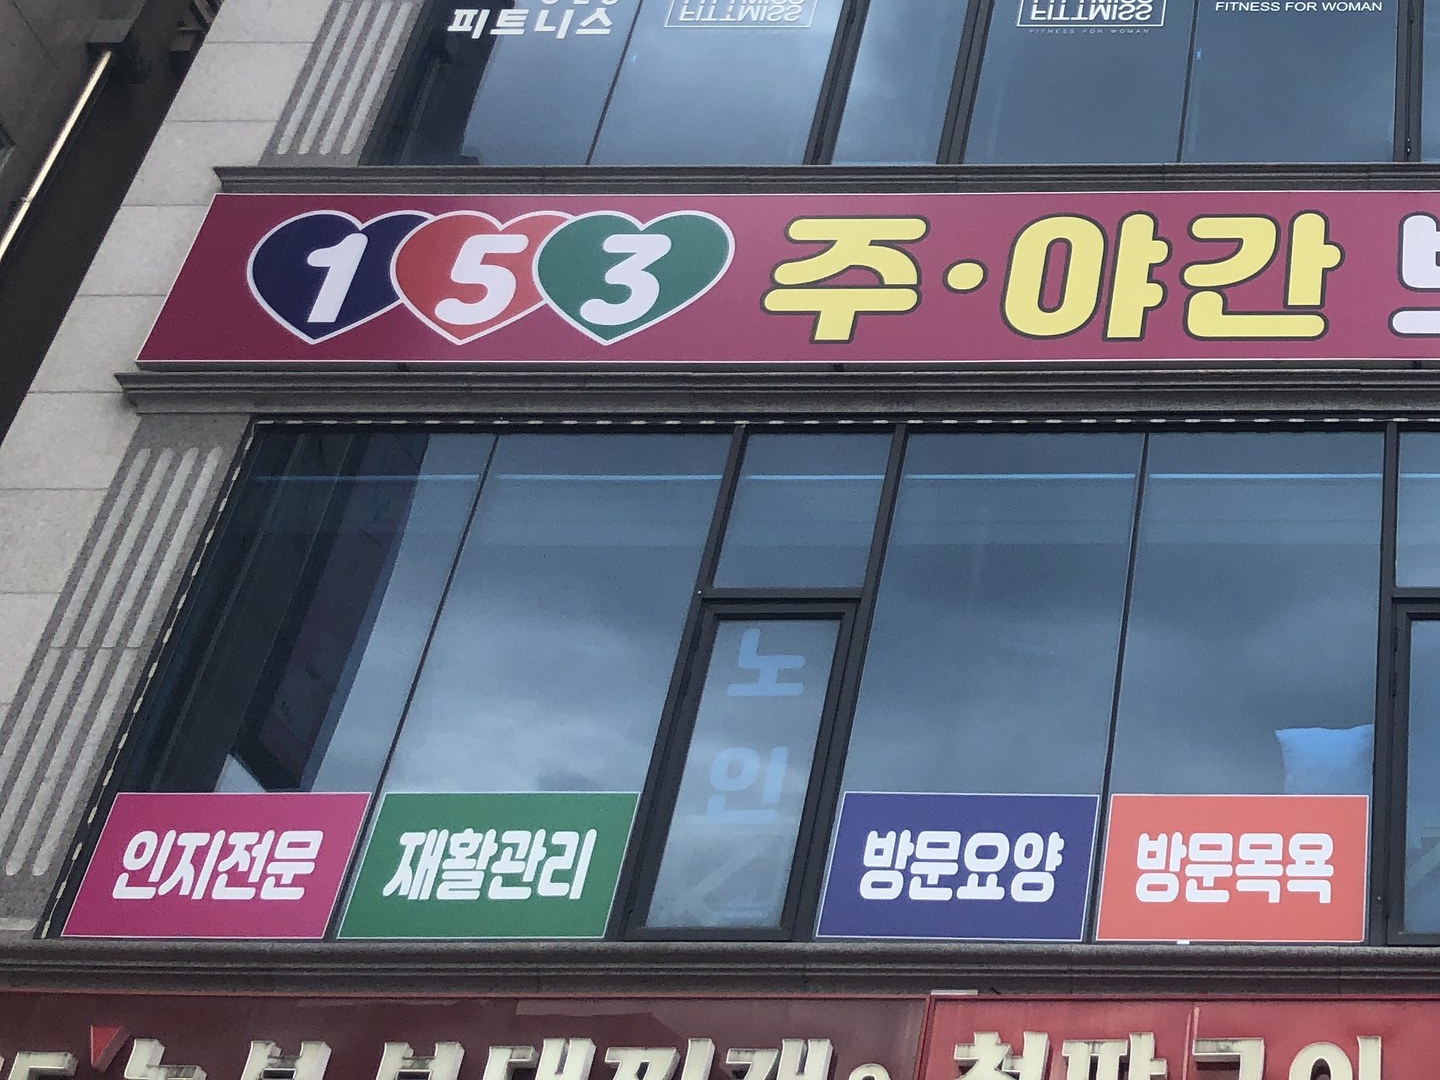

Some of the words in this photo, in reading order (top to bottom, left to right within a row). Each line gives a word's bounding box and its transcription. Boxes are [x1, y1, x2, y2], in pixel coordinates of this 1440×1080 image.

[447, 7, 613, 39] 피트니스
[1215, 1, 1280, 12] FITNESS
[1285, 1, 1317, 12] FOR
[1322, 1, 1383, 12] WOMAN
[111, 829, 324, 901] 인지전문
[383, 827, 598, 902] 재활관리
[861, 830, 1063, 903] 방문요양
[1135, 831, 1336, 904] 방문목욕
